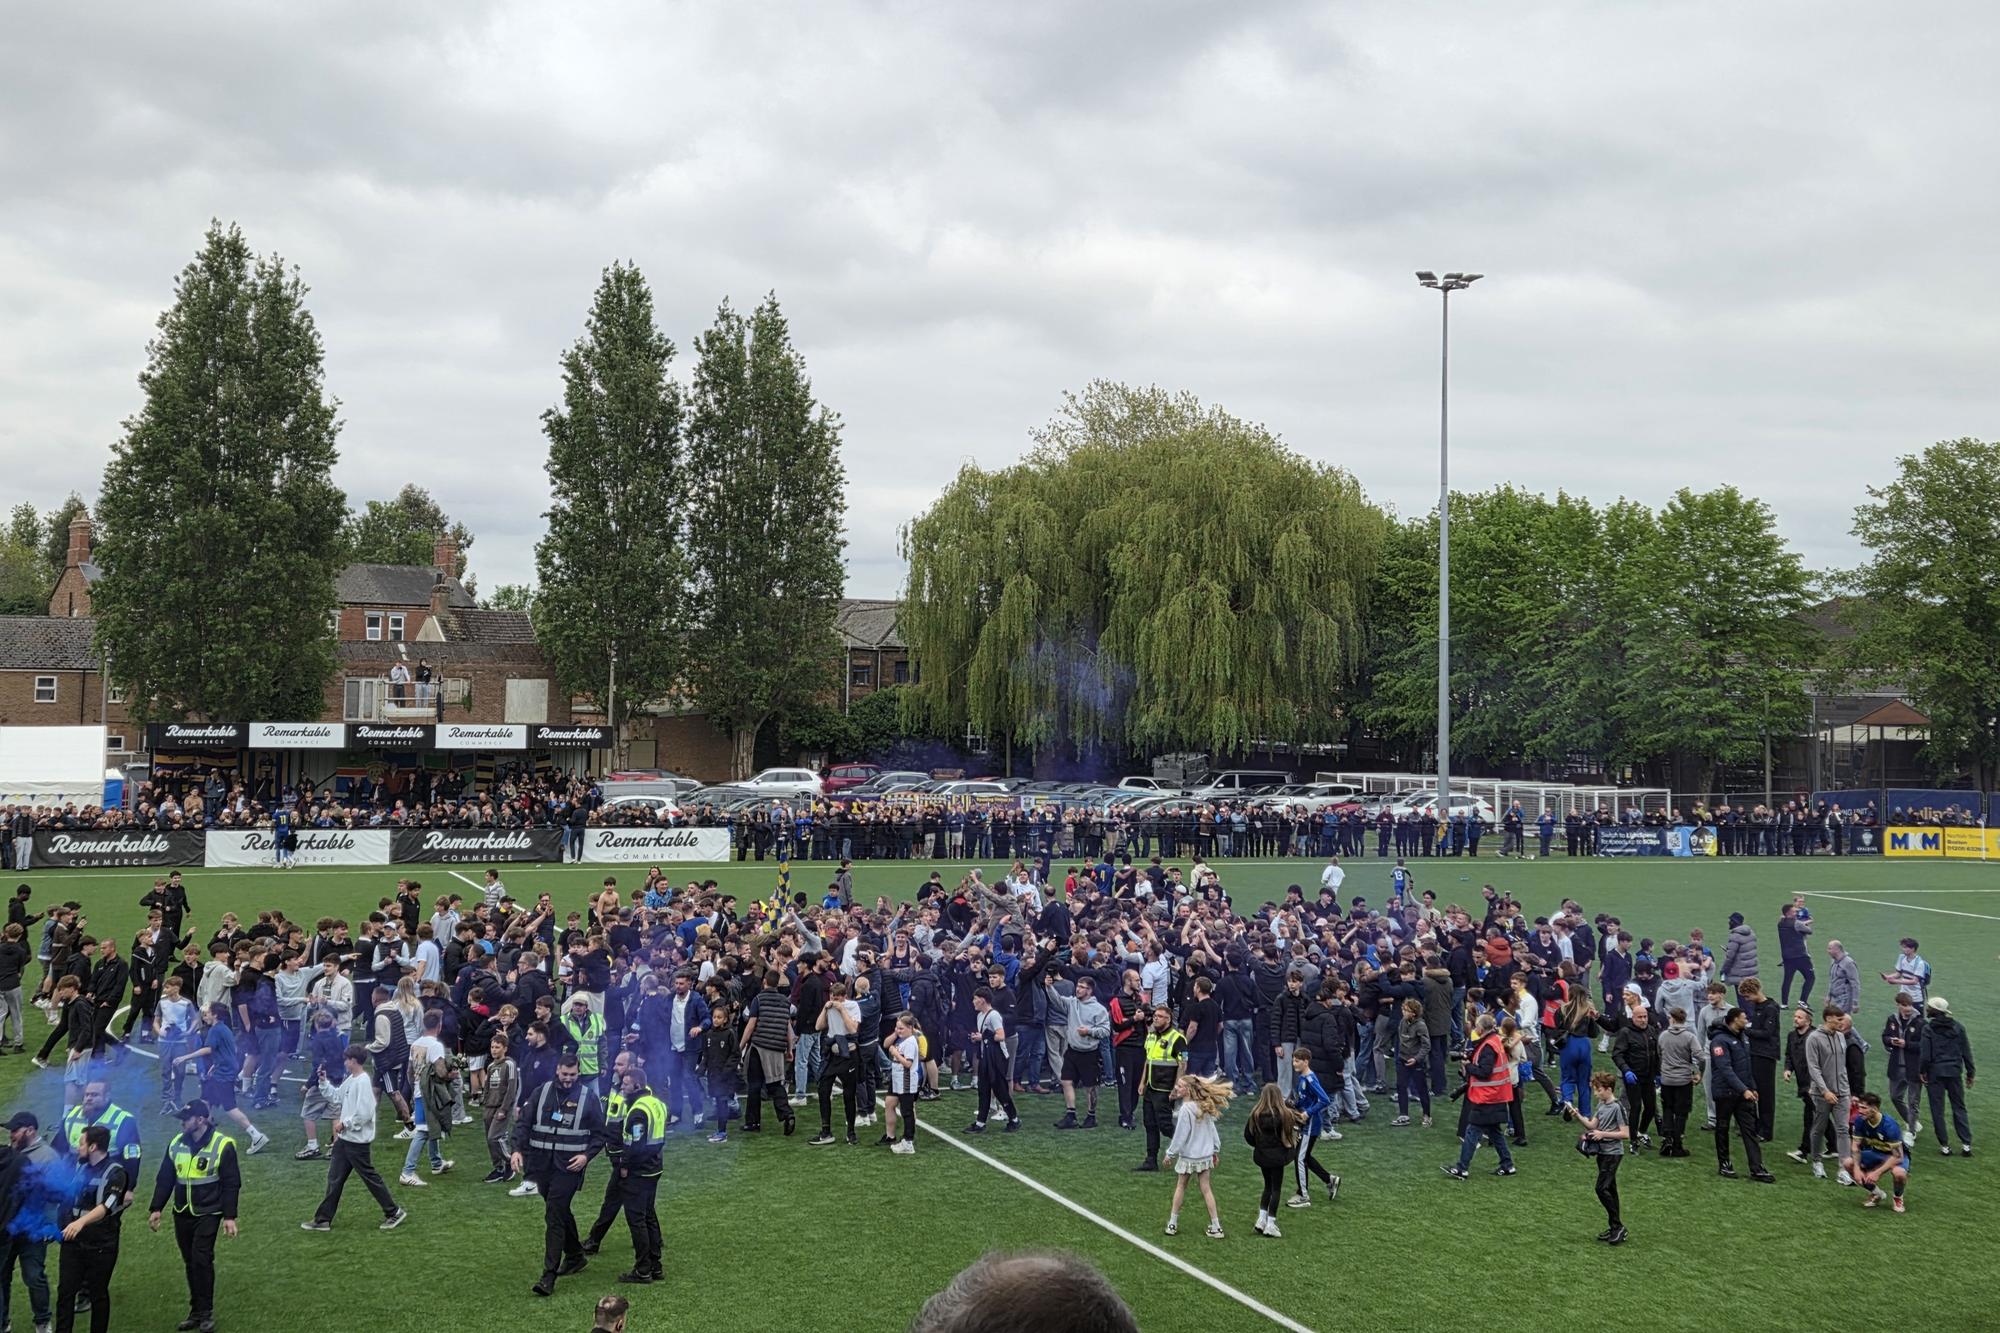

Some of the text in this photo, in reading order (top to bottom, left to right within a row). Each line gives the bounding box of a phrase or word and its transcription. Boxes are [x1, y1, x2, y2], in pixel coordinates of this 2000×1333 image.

[165, 724, 239, 737] Remarkable
[262, 725, 332, 737] Remarkable
[356, 725, 424, 738] Remarkable
[448, 726, 513, 738] Remarkable
[537, 726, 602, 739] Remarkable
[279, 814, 287, 825] 11
[48, 833, 170, 854] Remarkable
[241, 832, 356, 851] Rerkable
[422, 831, 532, 850] Remarkable
[595, 830, 699, 848] Remarkable
[1890, 832, 1940, 850] MKM
[69, 858, 148, 866] COMMERCE
[261, 856, 335, 864] COMERCE
[441, 854, 513, 862] COMMERCE
[1394, 870, 1404, 881] 13
